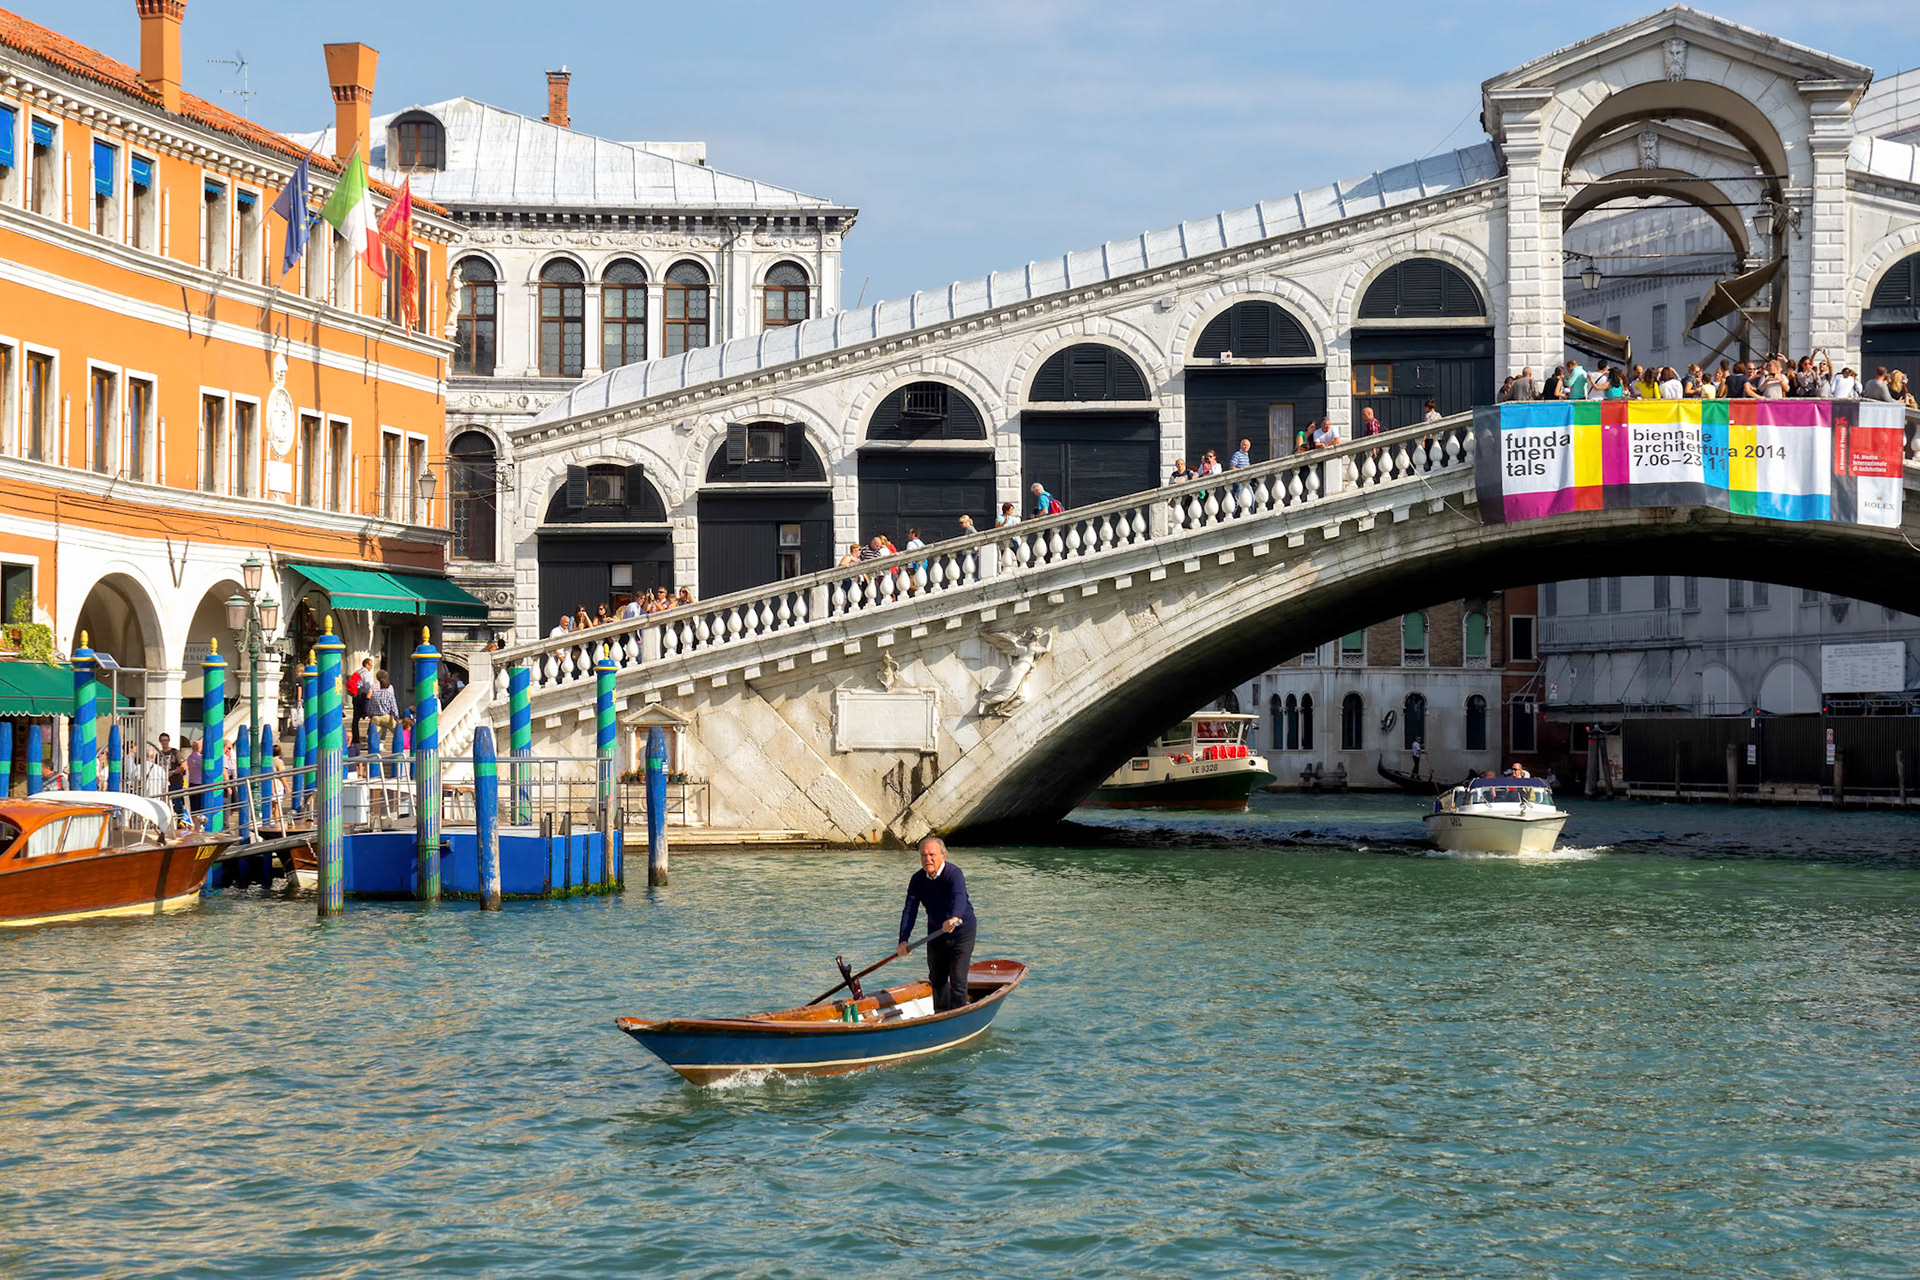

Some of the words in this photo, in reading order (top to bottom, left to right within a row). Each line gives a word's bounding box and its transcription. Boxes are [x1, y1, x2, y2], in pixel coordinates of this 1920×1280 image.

[1505, 431, 1571, 449] funda
[1633, 428, 1712, 443] biennale
[1507, 448, 1555, 461] men
[1633, 440, 1738, 458] architettura
[1744, 444, 1786, 460] 2014
[1506, 459, 1546, 477] tals
[1864, 501, 1895, 510] ROLEX
[1191, 766, 1200, 774] VE
